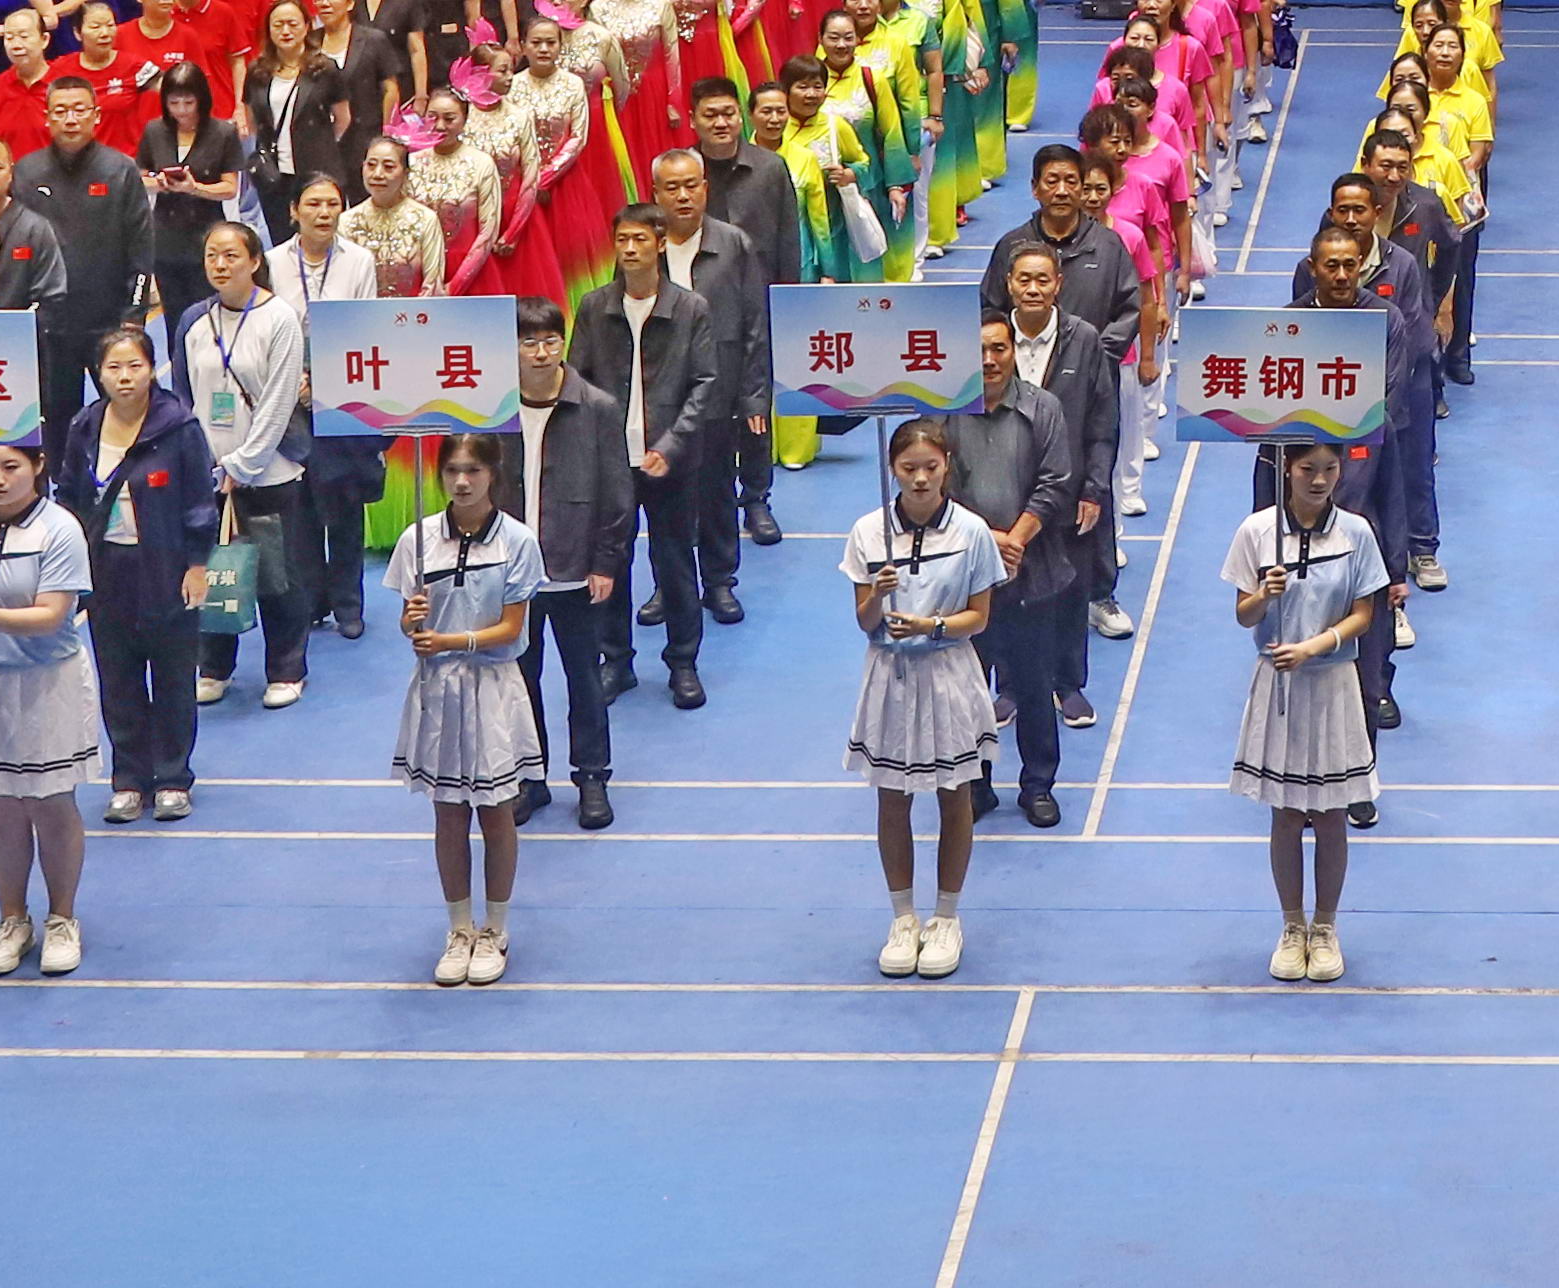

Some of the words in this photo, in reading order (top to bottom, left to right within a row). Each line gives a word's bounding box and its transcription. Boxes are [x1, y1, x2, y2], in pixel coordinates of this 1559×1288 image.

[345, 344, 483, 390] 叶县
[808, 328, 947, 374] 郏县
[1202, 353, 1362, 401] 舞钢市
